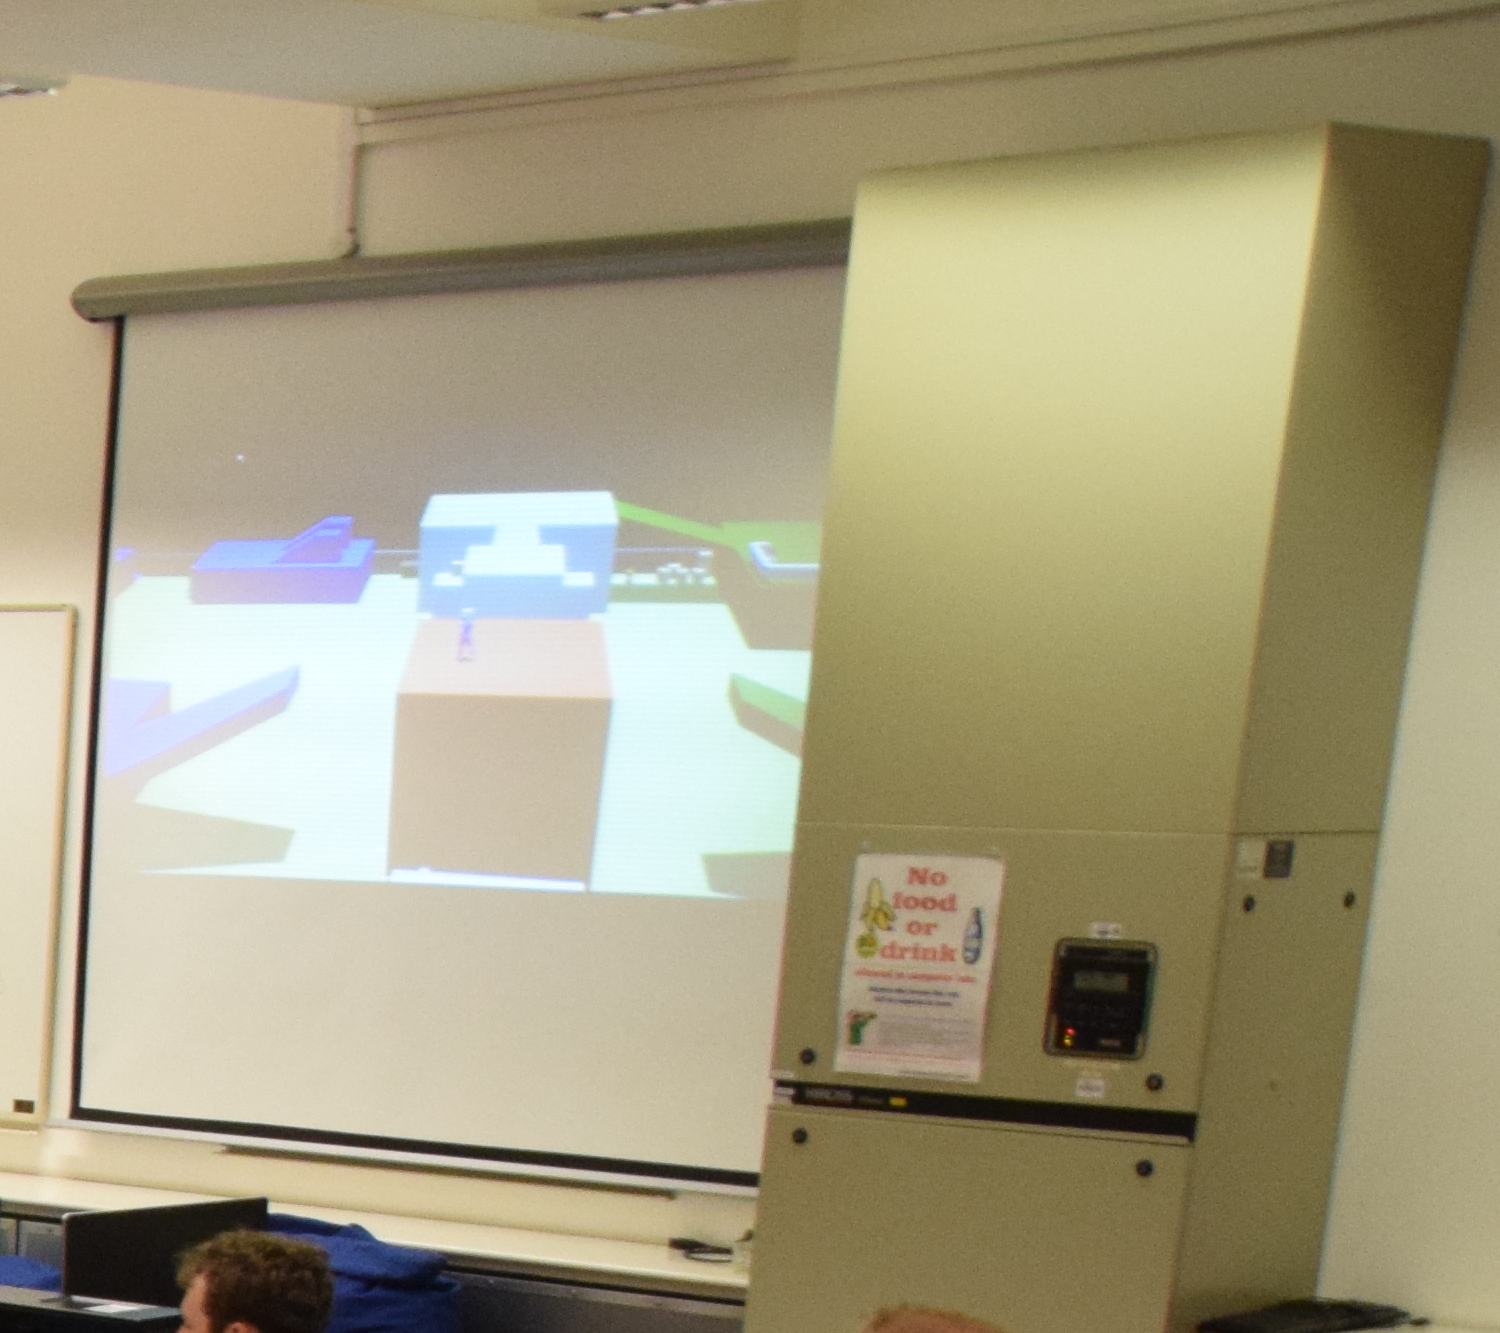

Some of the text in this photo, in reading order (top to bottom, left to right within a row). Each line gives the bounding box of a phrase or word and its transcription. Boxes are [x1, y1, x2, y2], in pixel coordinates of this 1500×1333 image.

[907, 867, 948, 886] No
[892, 892, 957, 912] food
[906, 920, 939, 935] or
[879, 940, 956, 962] drink
